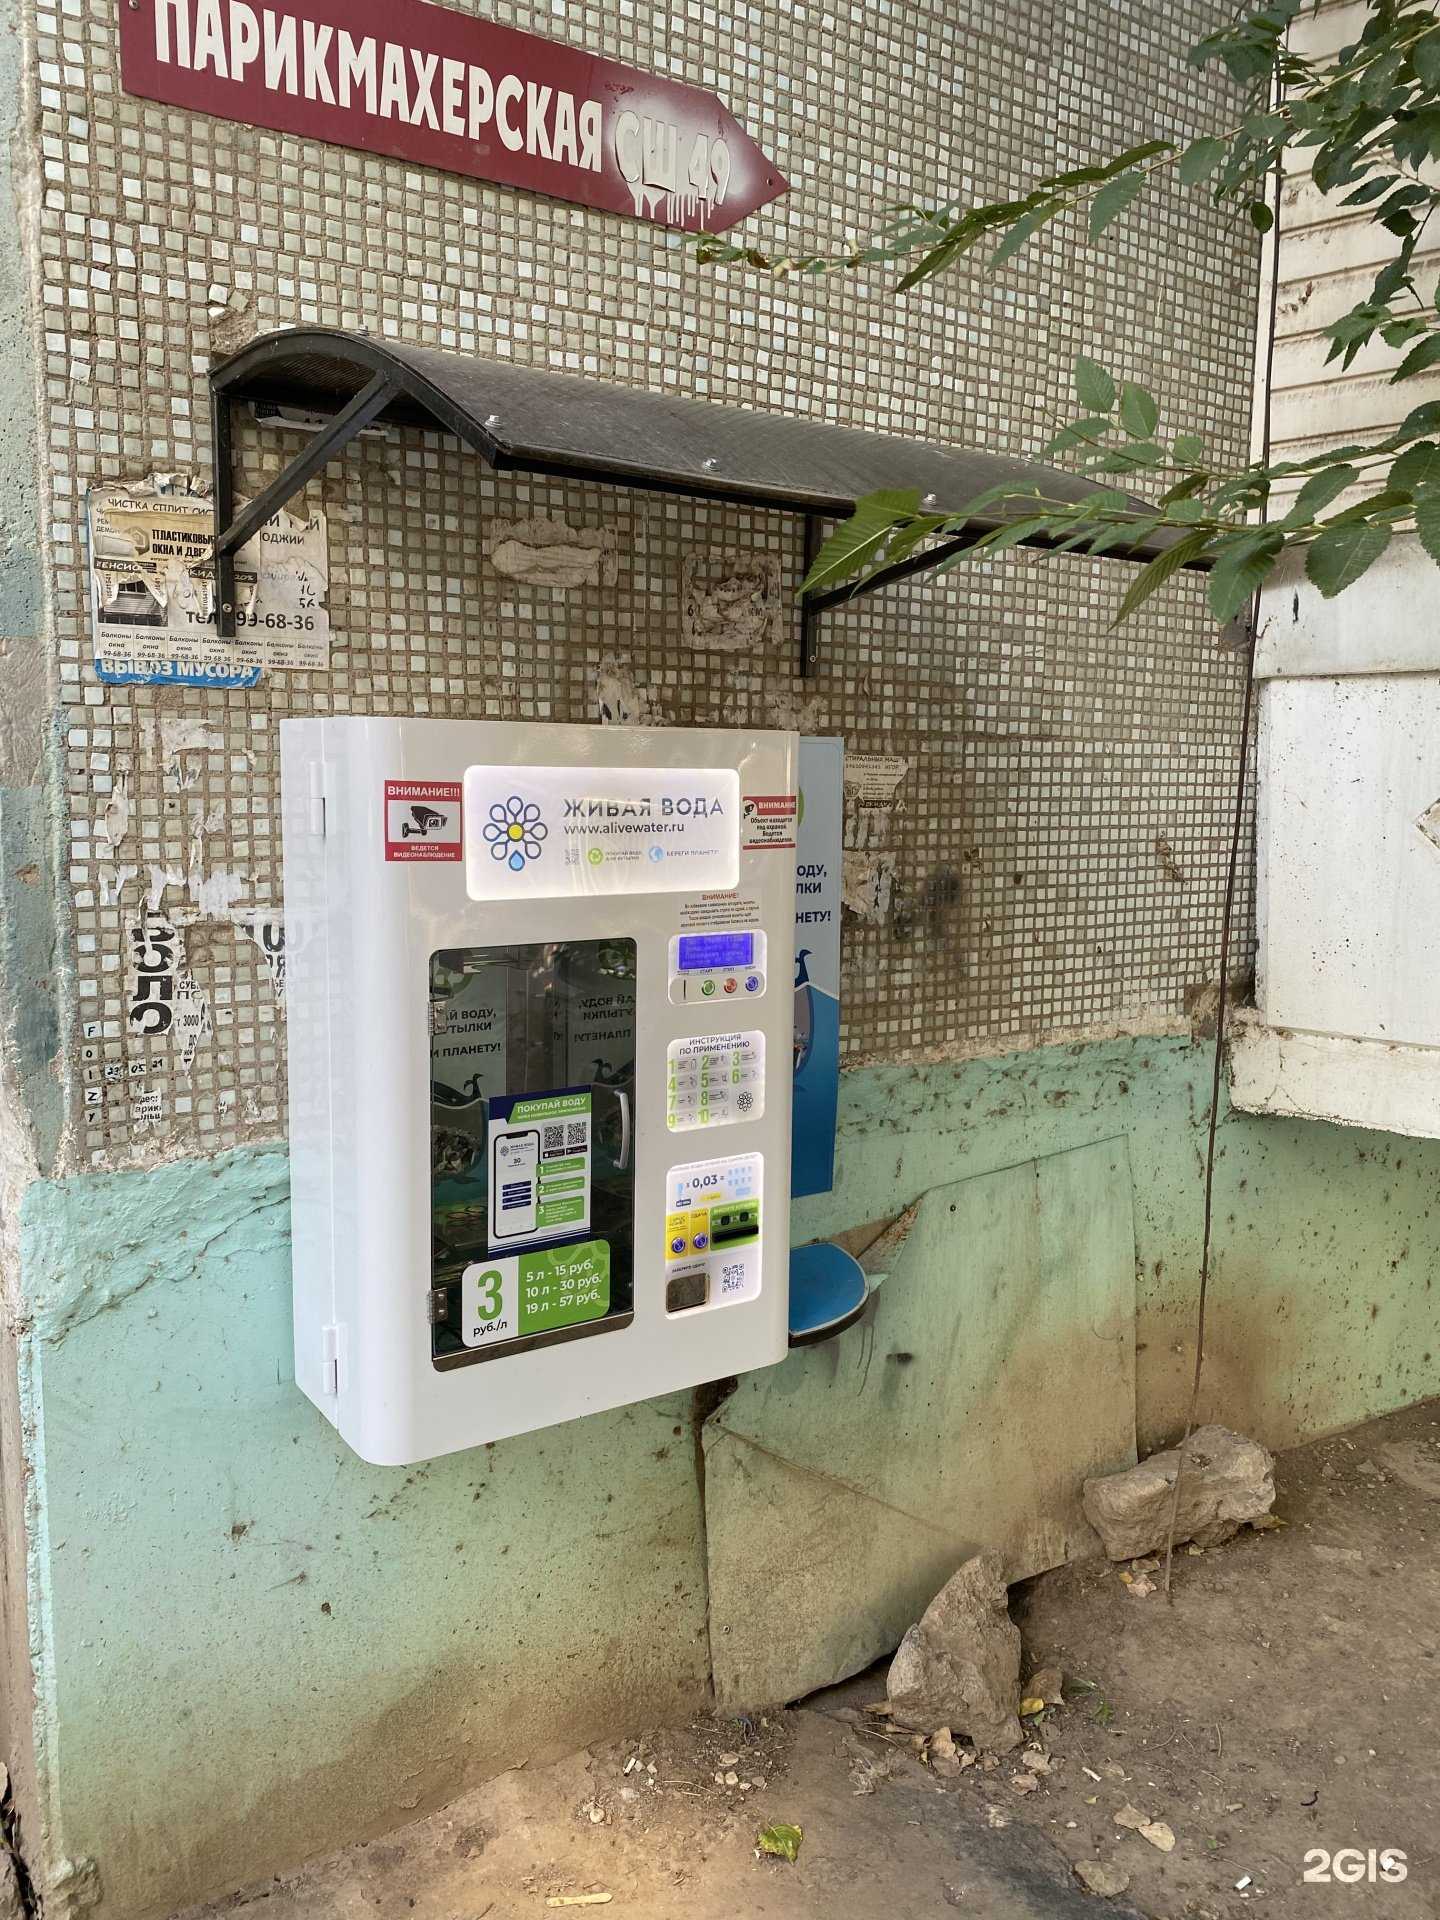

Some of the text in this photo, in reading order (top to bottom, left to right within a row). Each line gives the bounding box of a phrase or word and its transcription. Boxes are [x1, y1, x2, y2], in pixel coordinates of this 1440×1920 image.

[155, 0, 602, 172] ПАРИКМАХЕРСКАЯ
[108, 498, 148, 510] ЧИСТКА
[152, 504, 188, 514] СПЛИТ
[262, 532, 304, 545] ОДЖИИ
[152, 543, 206, 558] ОКНА И ДВЕ
[96, 561, 140, 571] ЕНСИО
[101, 631, 132, 639] Балконы
[101, 660, 254, 678] ВЫВОЗ МУСОРА
[388, 786, 460, 797] ВНИМАНИЕ!!!
[563, 797, 724, 818] ЖИВАЯ ВОДА
[564, 822, 685, 835] www.alivewater.ru
[796, 864, 828, 878] ОДУ,
[796, 882, 822, 894] ЛКИ
[795, 910, 832, 924] НЕТУ!
[183, 1014, 199, 1026] 3000
[461, 1008, 497, 1020] ВОДУ,
[448, 1021, 492, 1034] ТЫЛКИ
[689, 1034, 742, 1046] ИНСТРУКЦИЯ
[443, 1042, 501, 1057] ПЛАНЕТУ!
[693, 1041, 750, 1054] ПРИМЕНЕНИЮ
[669, 1059, 675, 1071] 1
[702, 1055, 709, 1070] 2
[733, 1051, 740, 1066] 3
[668, 1077, 676, 1090] 4
[701, 1073, 709, 1088] 5
[732, 1070, 740, 1084] 6
[518, 1100, 560, 1113] ПОКУПАЙ
[562, 1096, 586, 1107] ВОДУ
[668, 1095, 676, 1110] 7
[701, 1091, 708, 1106] 8
[668, 1114, 676, 1128] 9
[698, 1109, 710, 1123] 10
[540, 1166, 544, 1174] 1
[692, 1175, 718, 1188] 0,03
[539, 1185, 545, 1194] 2
[539, 1205, 545, 1215] 3
[526, 1272, 534, 1282] 5
[535, 1272, 544, 1280] л
[555, 1265, 566, 1276] 15
[569, 1258, 594, 1274] руб.
[526, 1287, 539, 1298] 10
[541, 1286, 550, 1294] л
[560, 1280, 575, 1290] 30
[577, 1274, 602, 1290] руб.
[477, 1270, 503, 1321] 3
[526, 1303, 538, 1315] 19
[540, 1303, 549, 1312] л
[559, 1296, 574, 1308] 57
[576, 1289, 601, 1306] руб.
[473, 1319, 508, 1338] руб./л
